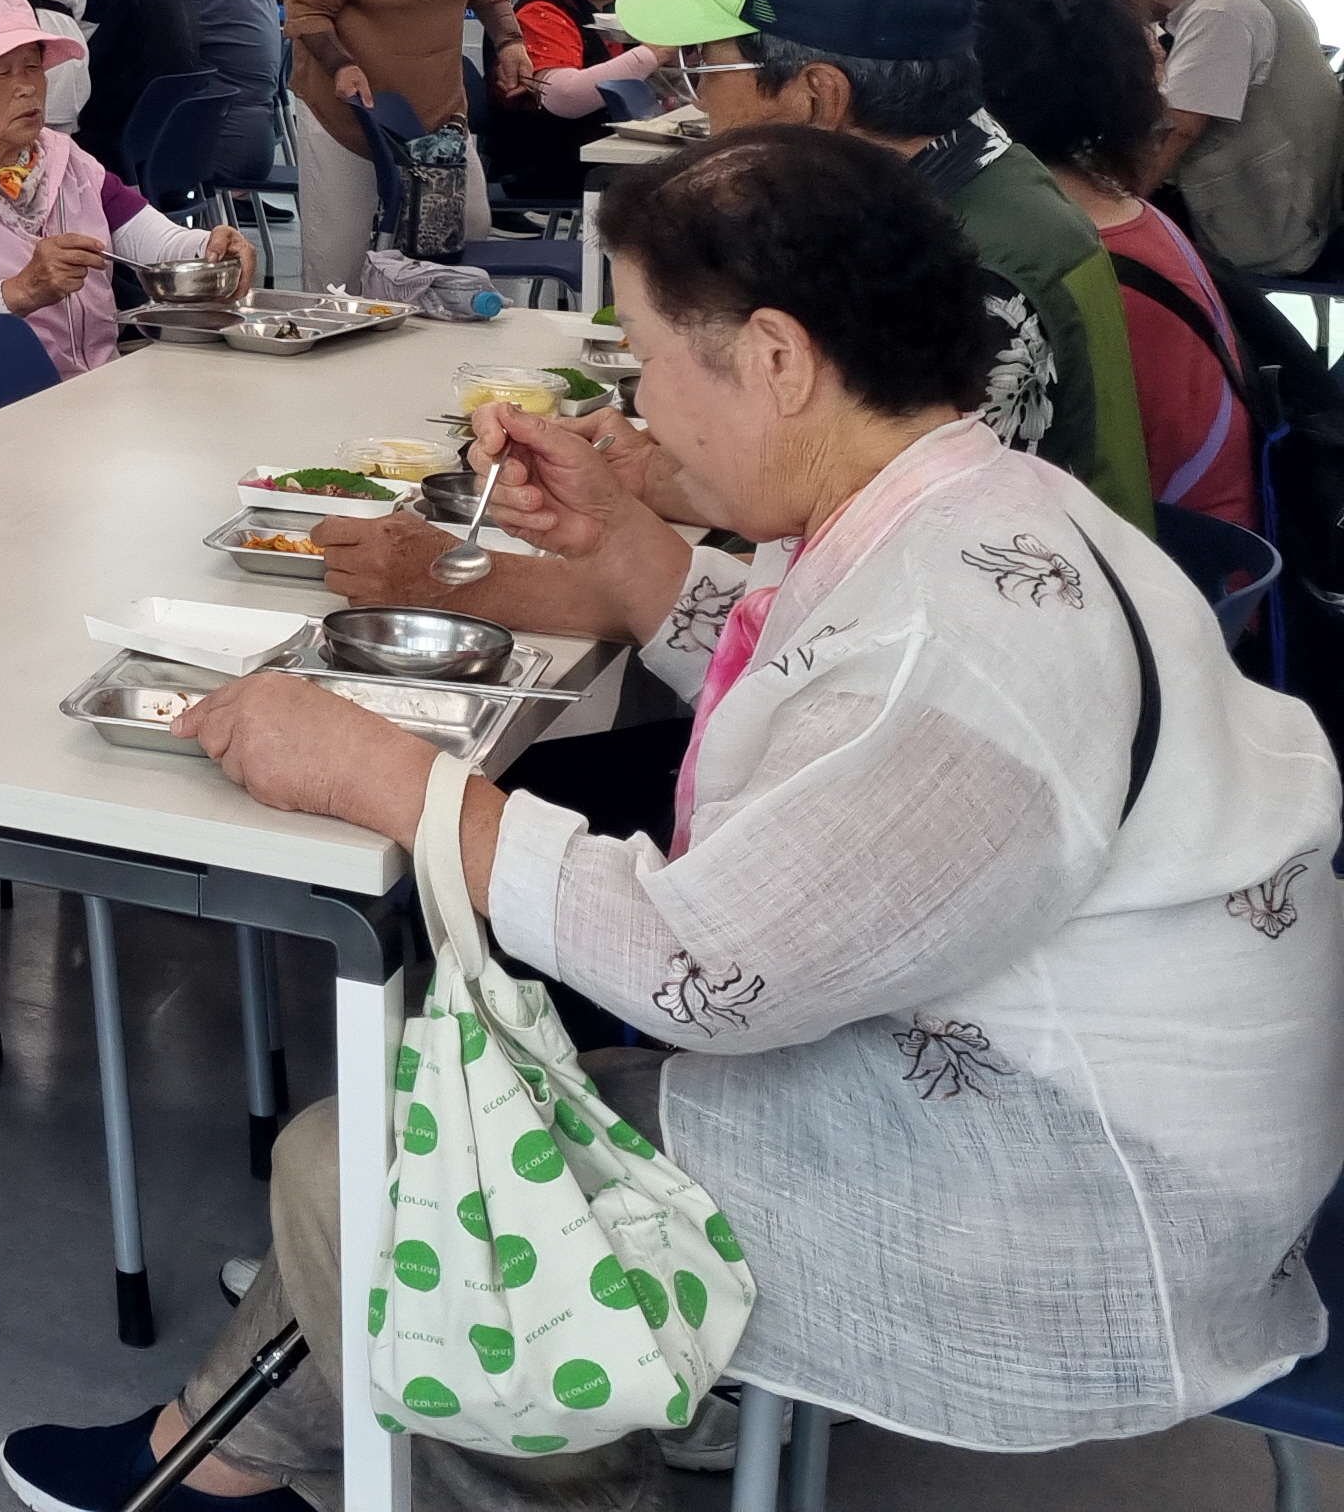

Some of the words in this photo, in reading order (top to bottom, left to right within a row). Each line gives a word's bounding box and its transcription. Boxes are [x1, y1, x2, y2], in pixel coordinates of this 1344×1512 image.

[482, 1083, 521, 1114] ECOLOV
[398, 1194, 439, 1210] COLOVE
[561, 1210, 594, 1236] ECOLO
[596, 1277, 629, 1300] ECOLO
[397, 1331, 444, 1346] ECOLOVE
[525, 1308, 573, 1344] ECOLOVE
[558, 1375, 606, 1402] ECOLOVE
